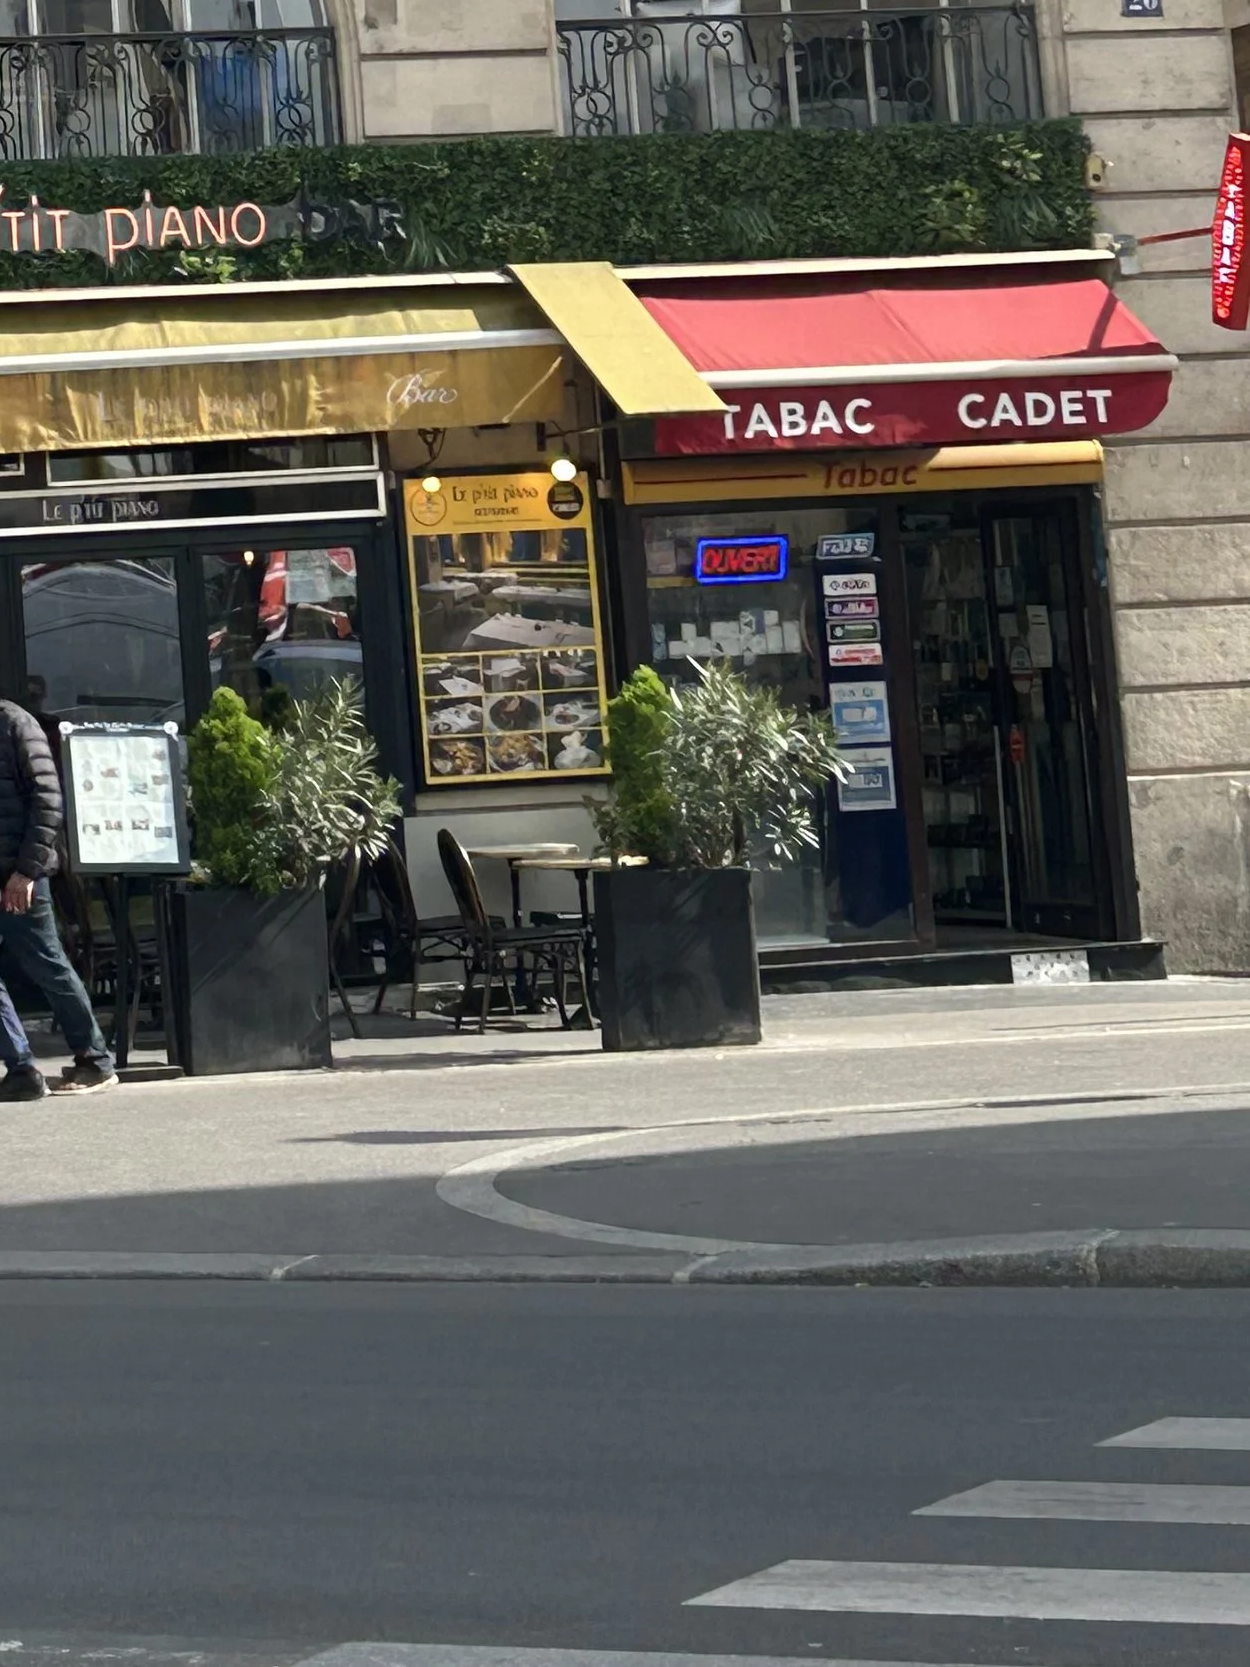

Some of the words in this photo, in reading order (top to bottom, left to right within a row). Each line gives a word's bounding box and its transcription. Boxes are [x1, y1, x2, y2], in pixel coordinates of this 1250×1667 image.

[386, 372, 458, 405] Bar
[723, 398, 875, 440] TABAC
[957, 390, 1112, 429] CADET
[820, 460, 917, 489] Tabac
[703, 544, 780, 574] OUVERT
